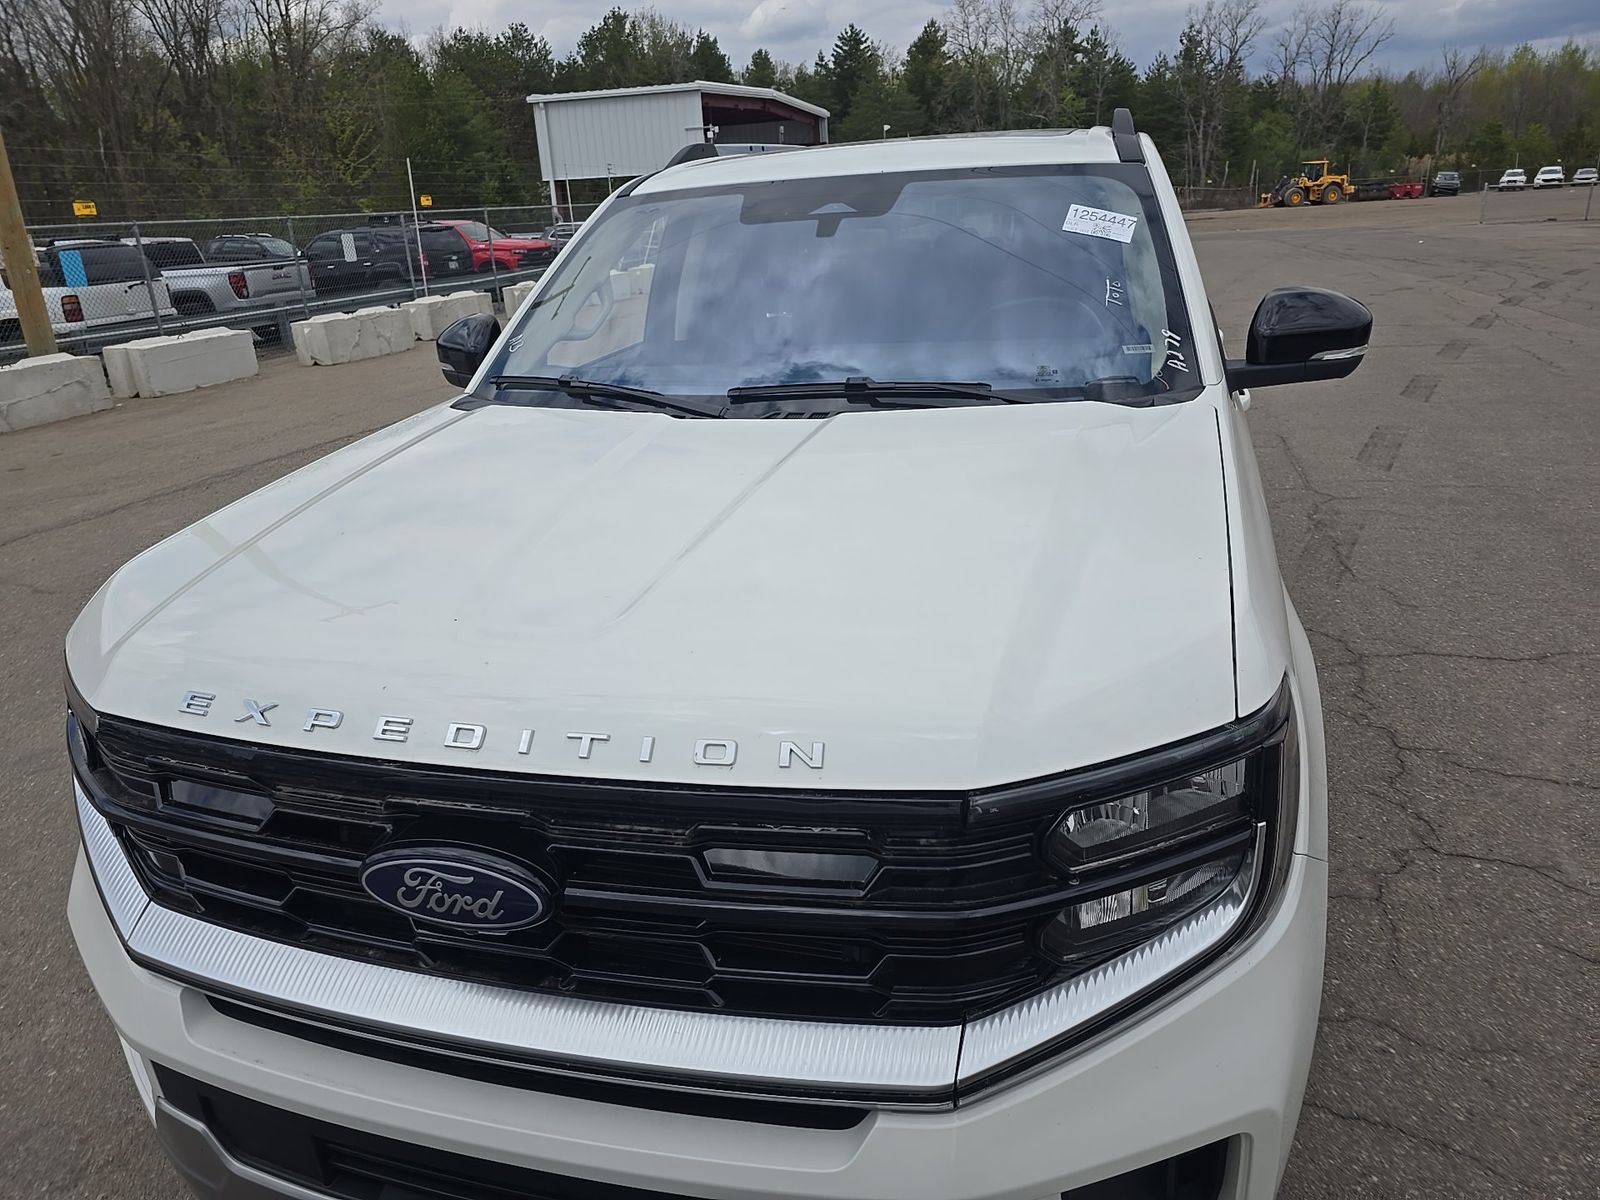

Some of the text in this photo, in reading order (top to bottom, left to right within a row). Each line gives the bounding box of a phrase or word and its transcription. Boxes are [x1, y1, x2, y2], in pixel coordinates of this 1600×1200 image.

[1073, 208, 1137, 228] 1254447
[178, 690, 825, 770] EXPEDITION
[397, 867, 504, 920] Ford
